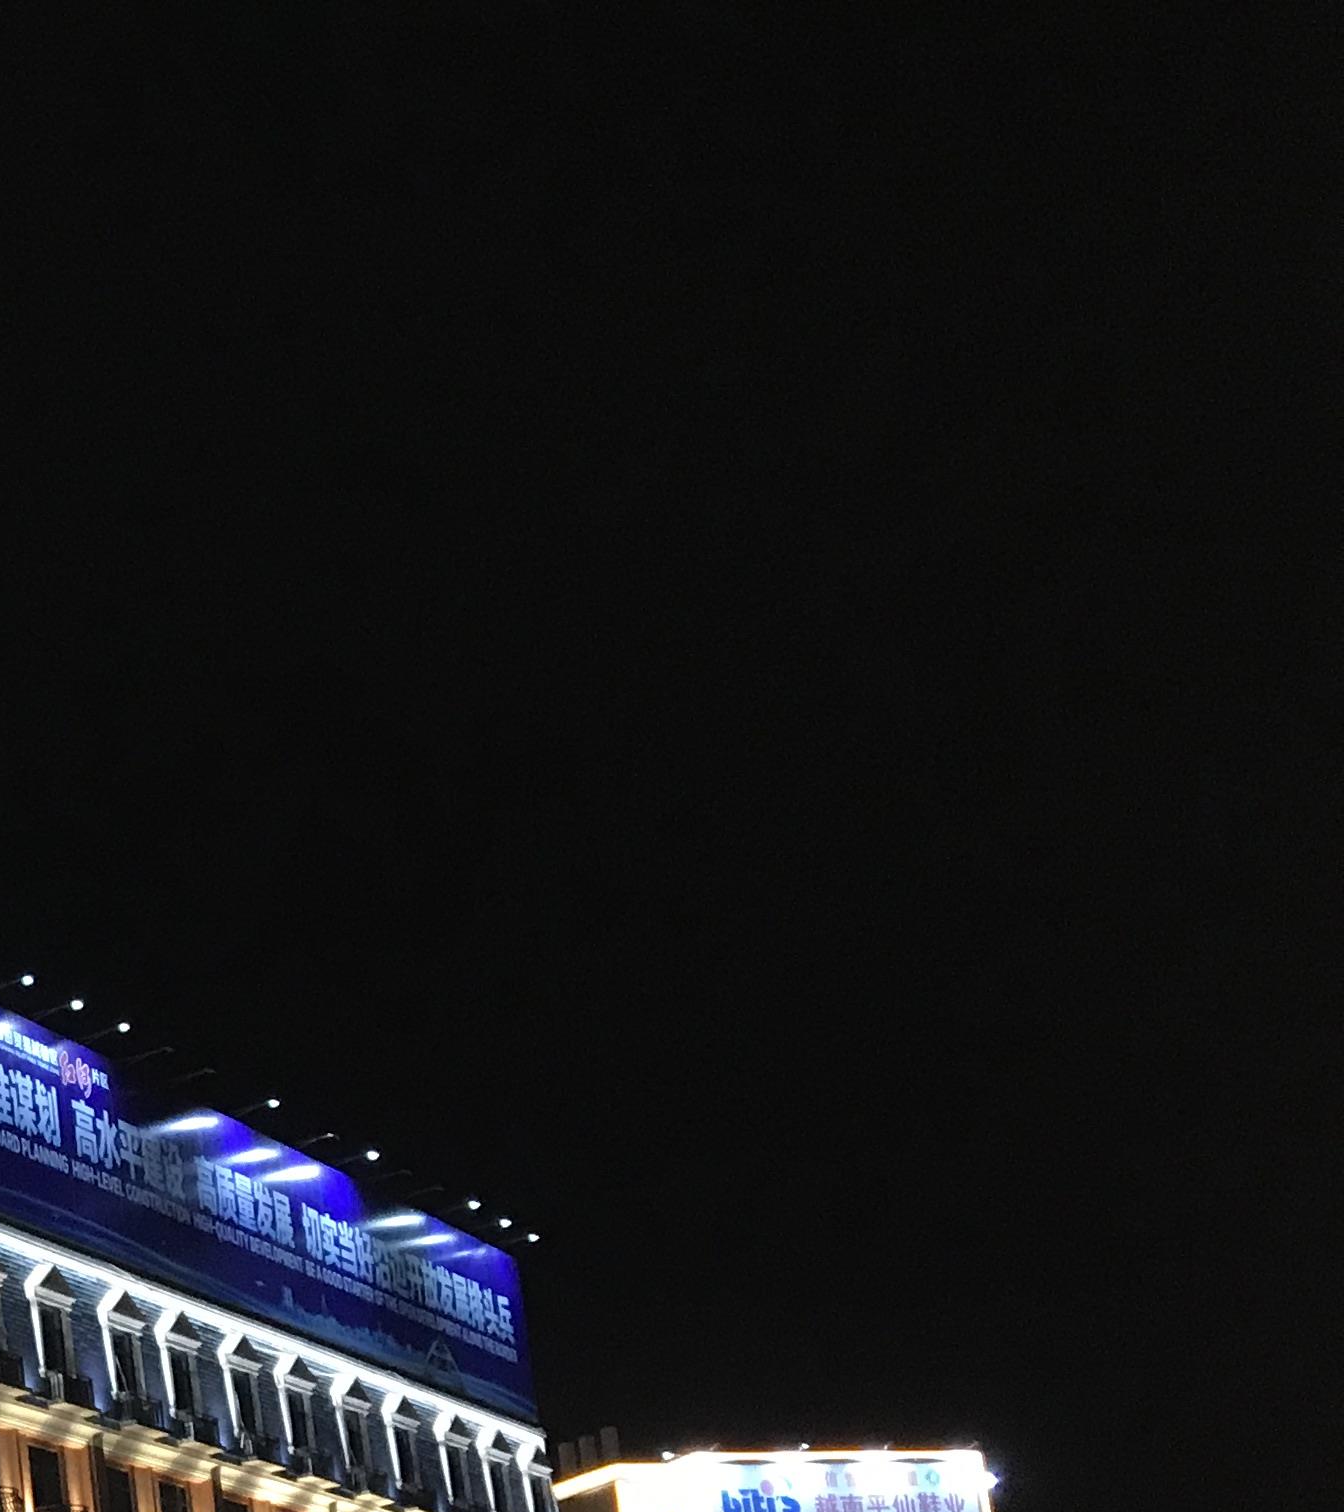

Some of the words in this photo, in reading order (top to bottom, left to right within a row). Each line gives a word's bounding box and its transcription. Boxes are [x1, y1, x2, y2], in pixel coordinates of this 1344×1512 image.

[21, 1137, 70, 1175] PLANNING
[71, 1158, 126, 1198] HIGH-LEVEL
[194, 1155, 295, 1249] 高质量发展
